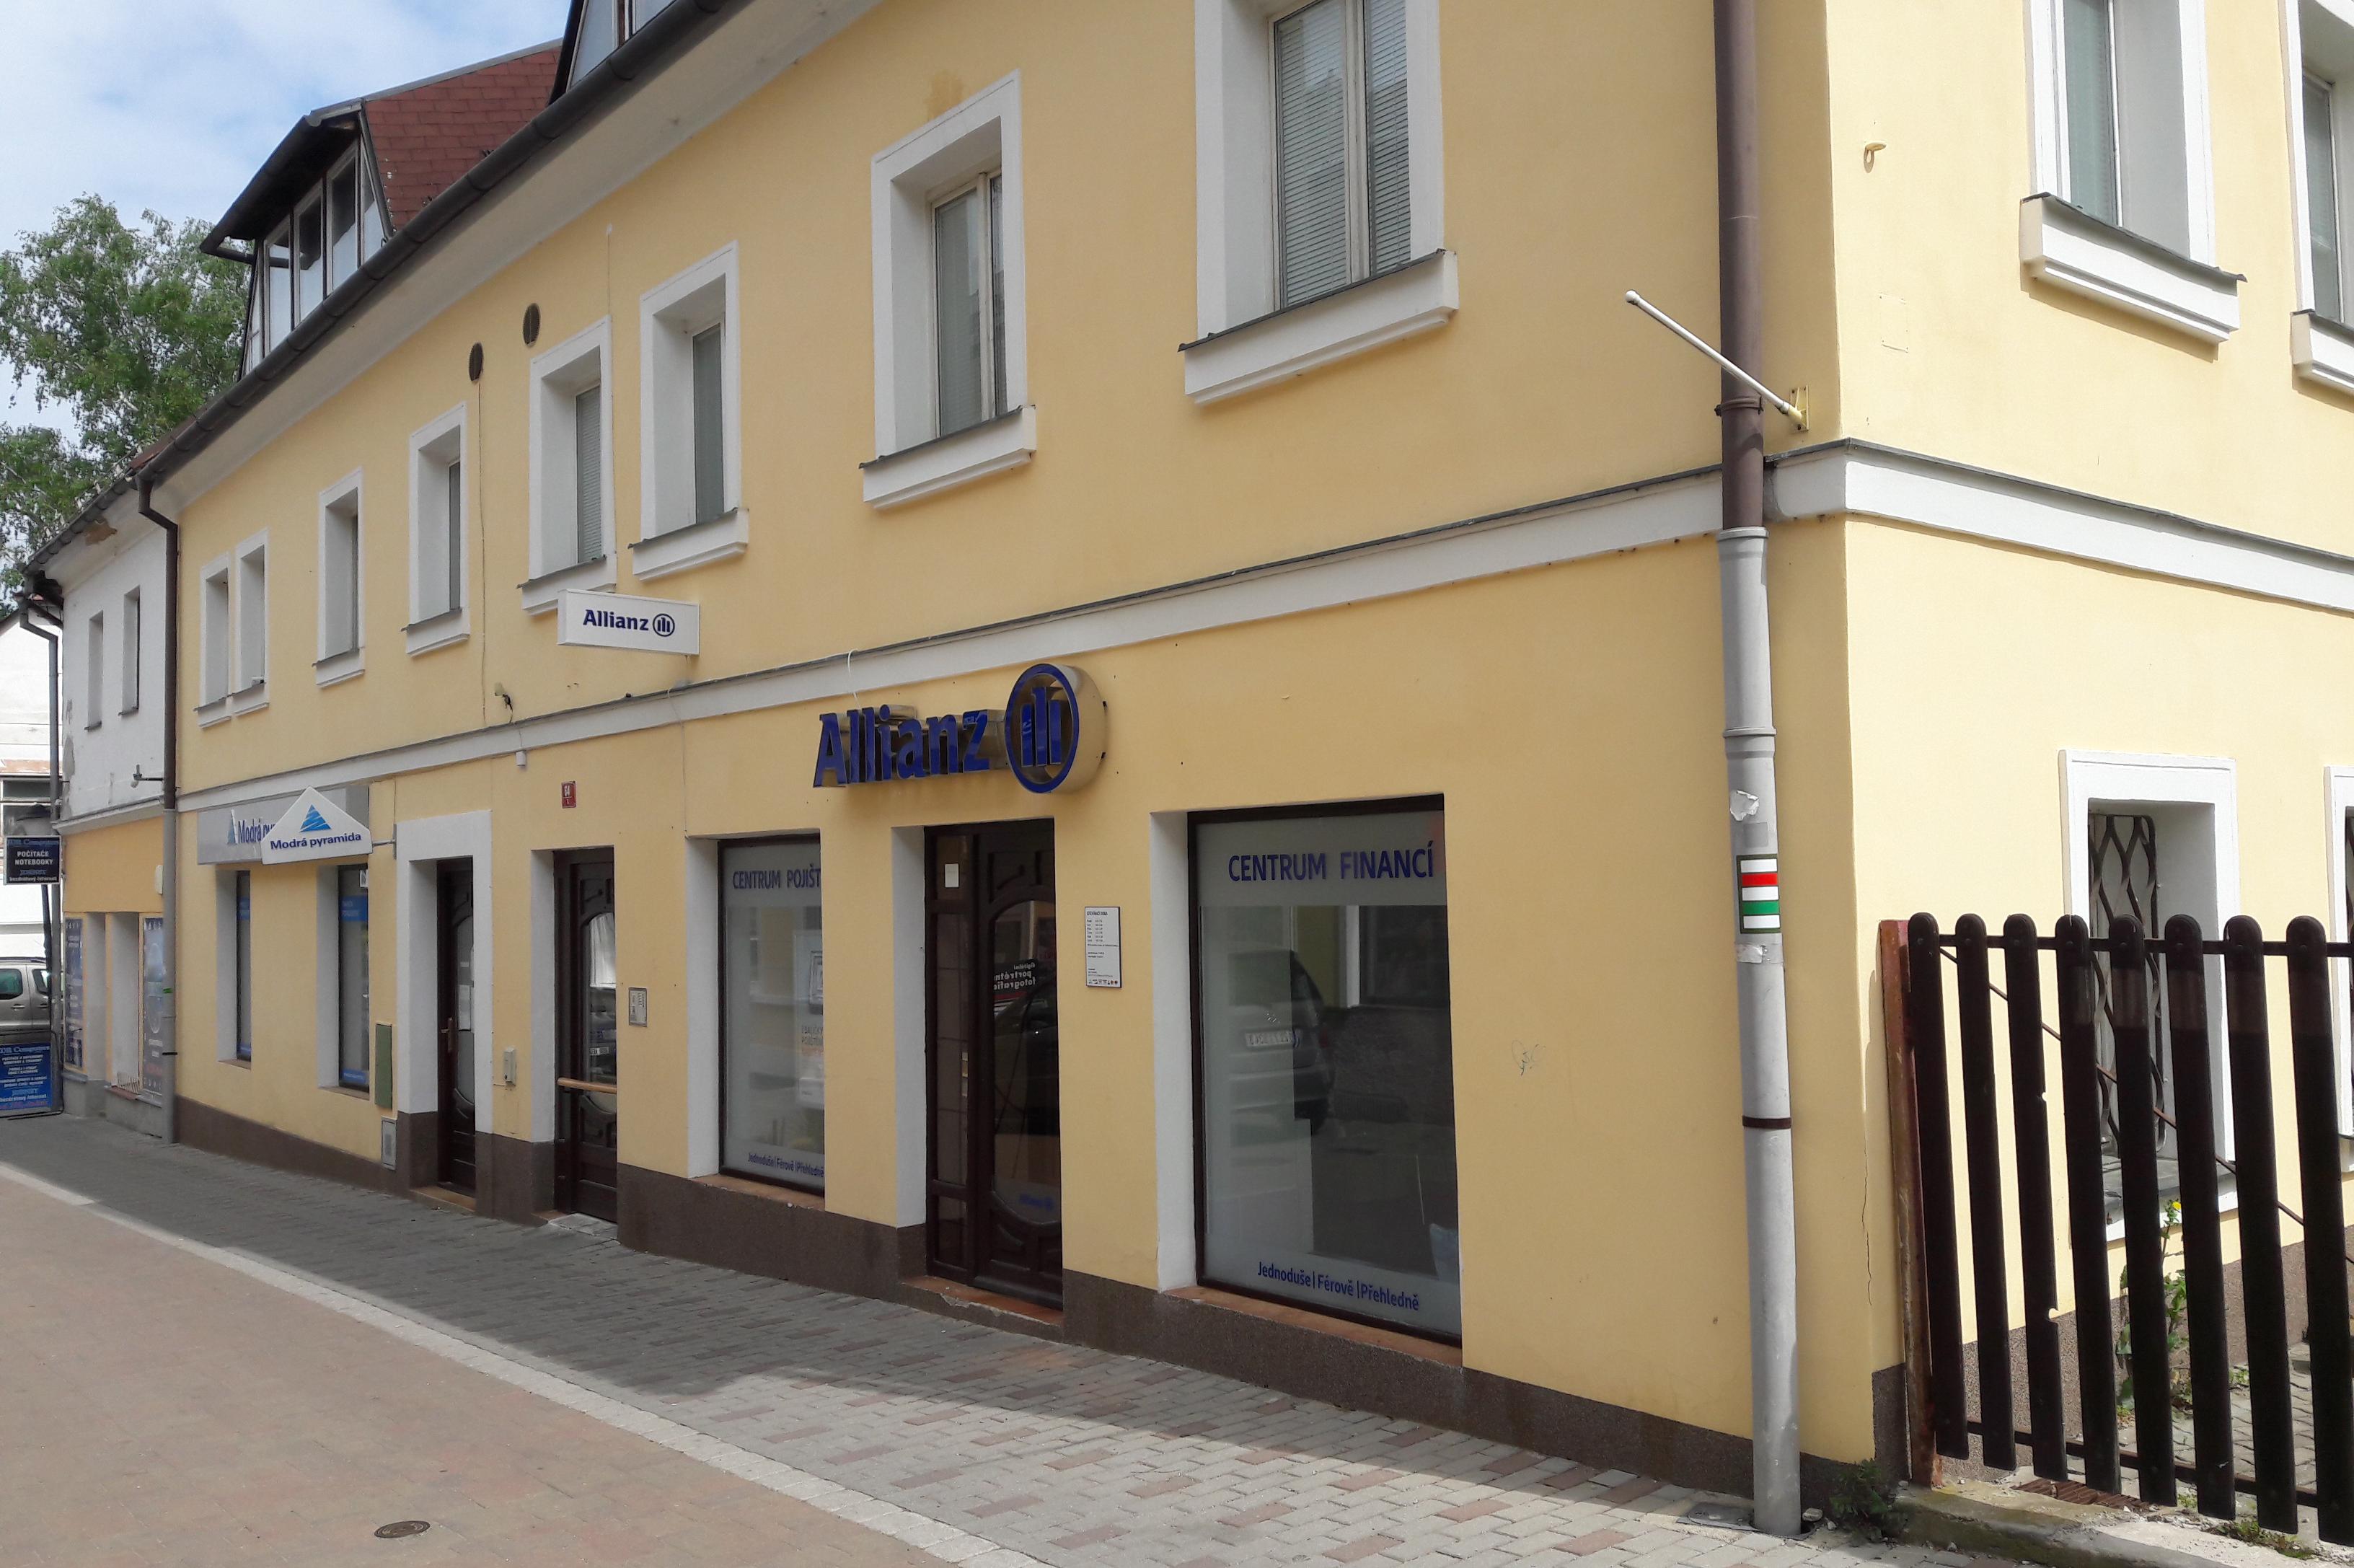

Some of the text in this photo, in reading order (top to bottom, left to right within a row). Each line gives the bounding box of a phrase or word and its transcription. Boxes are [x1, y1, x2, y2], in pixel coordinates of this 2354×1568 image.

[583, 609, 649, 631] Allianz
[813, 704, 990, 788] Allianz
[238, 818, 261, 844] Modrá
[270, 832, 362, 850] Modrá pyramida
[1228, 840, 1434, 881] CENTRUM FINANCÍ
[733, 870, 780, 889] CENTRUM
[1258, 1261, 1311, 1287] Jednoduše
[1318, 1274, 1354, 1297] Férově
[1361, 1284, 1419, 1311] Přehledně
